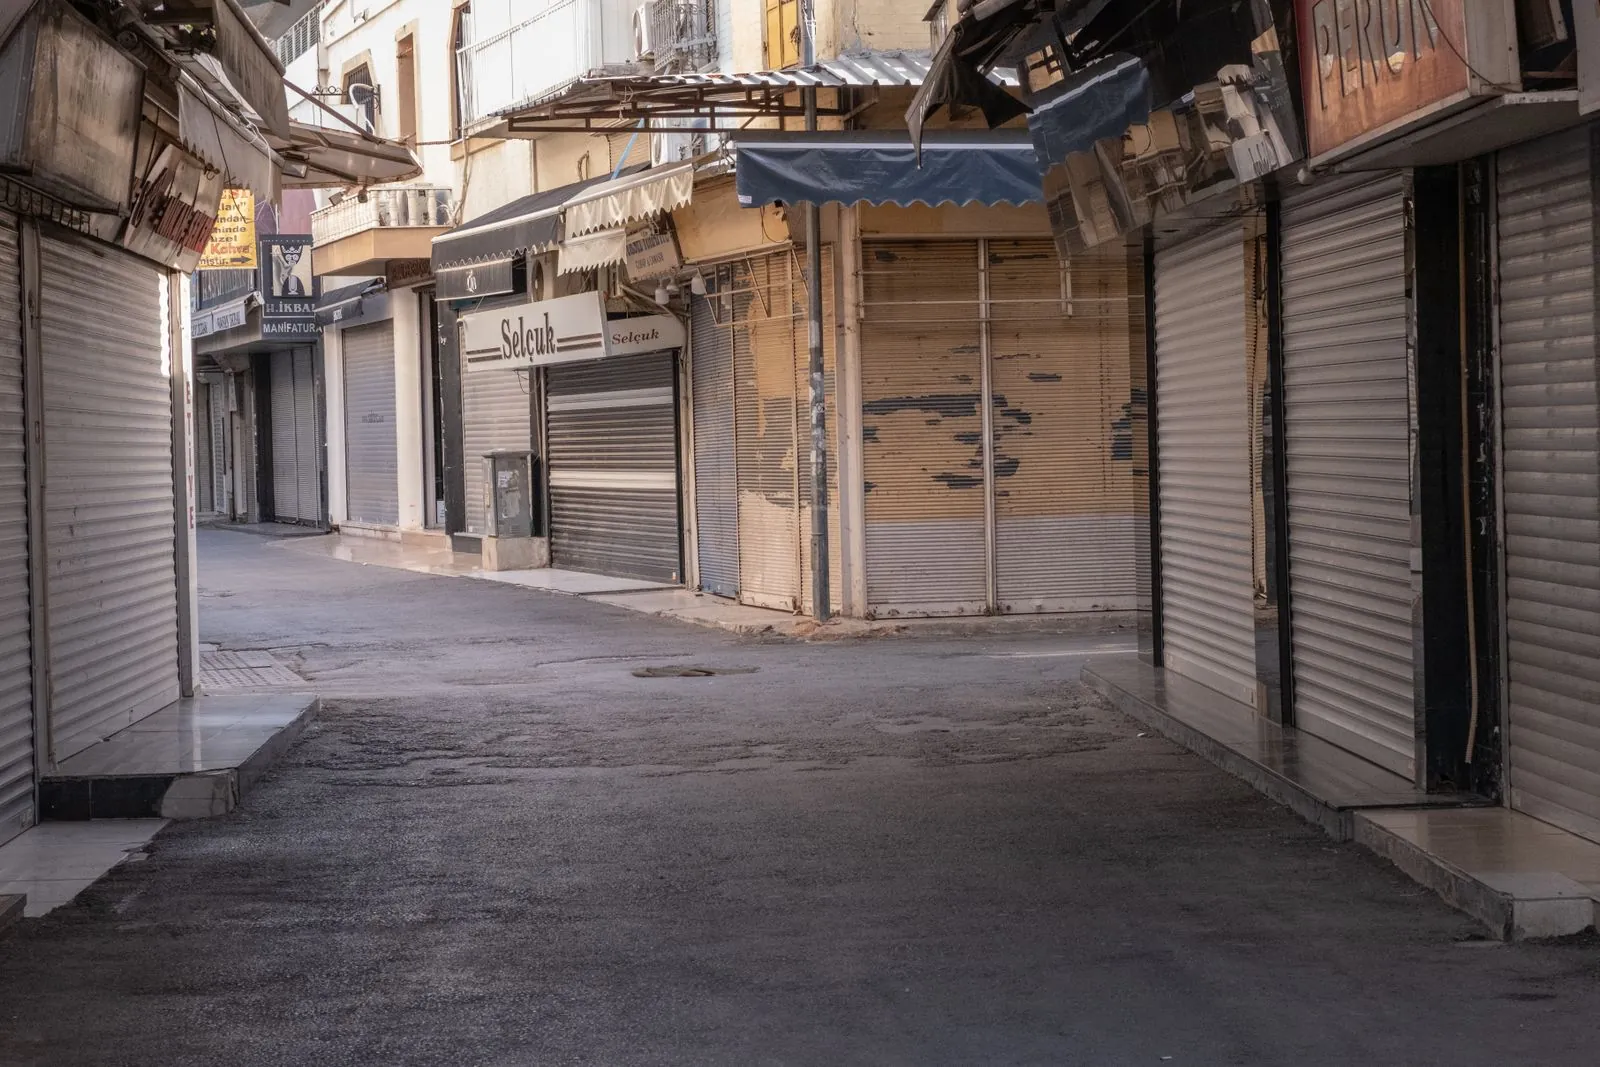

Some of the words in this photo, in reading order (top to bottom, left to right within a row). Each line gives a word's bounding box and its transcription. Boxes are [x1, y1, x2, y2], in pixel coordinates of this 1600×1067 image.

[263, 321, 323, 333] MANİFATURA
[501, 312, 556, 362] Selçuk
[611, 328, 660, 345] Selçuk
